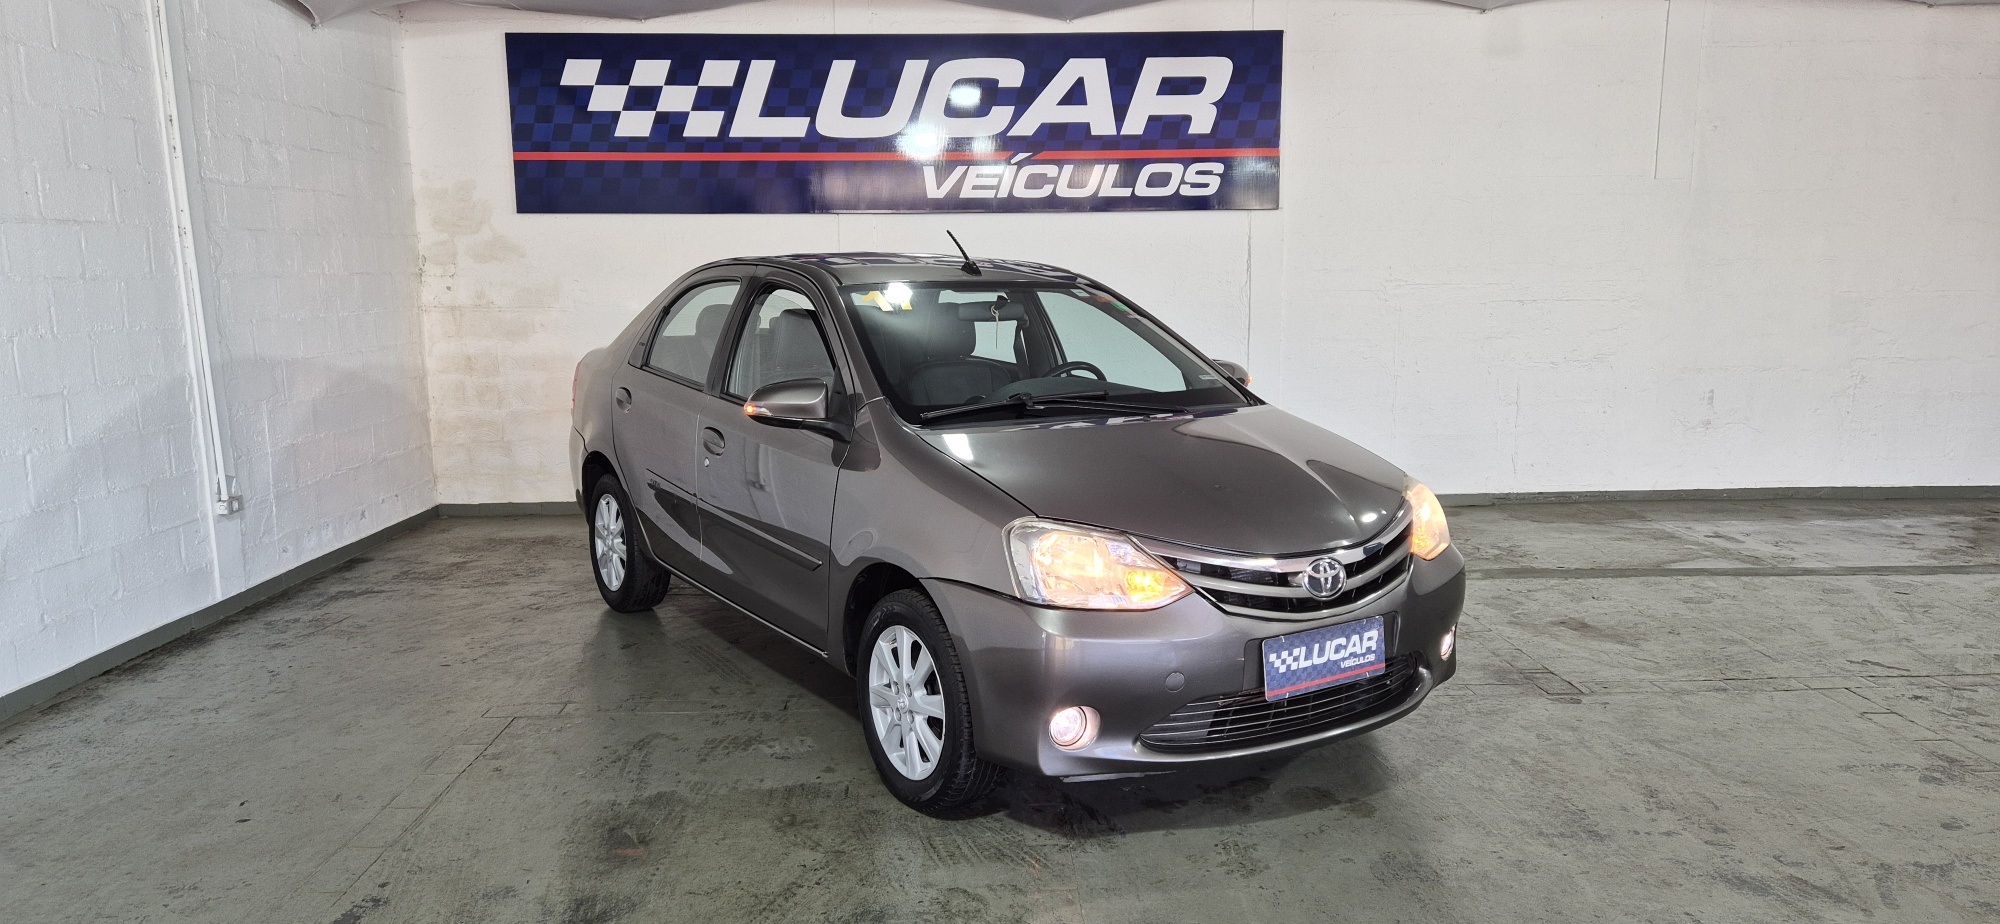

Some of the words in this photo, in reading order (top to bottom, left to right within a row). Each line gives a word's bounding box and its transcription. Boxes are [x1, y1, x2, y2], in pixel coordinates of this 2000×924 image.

[728, 56, 1233, 138] LUCAR
[922, 153, 1225, 199] VEÍCULOS
[1299, 630, 1379, 668] LUCAR
[1340, 653, 1376, 668] VEÍCULOS
